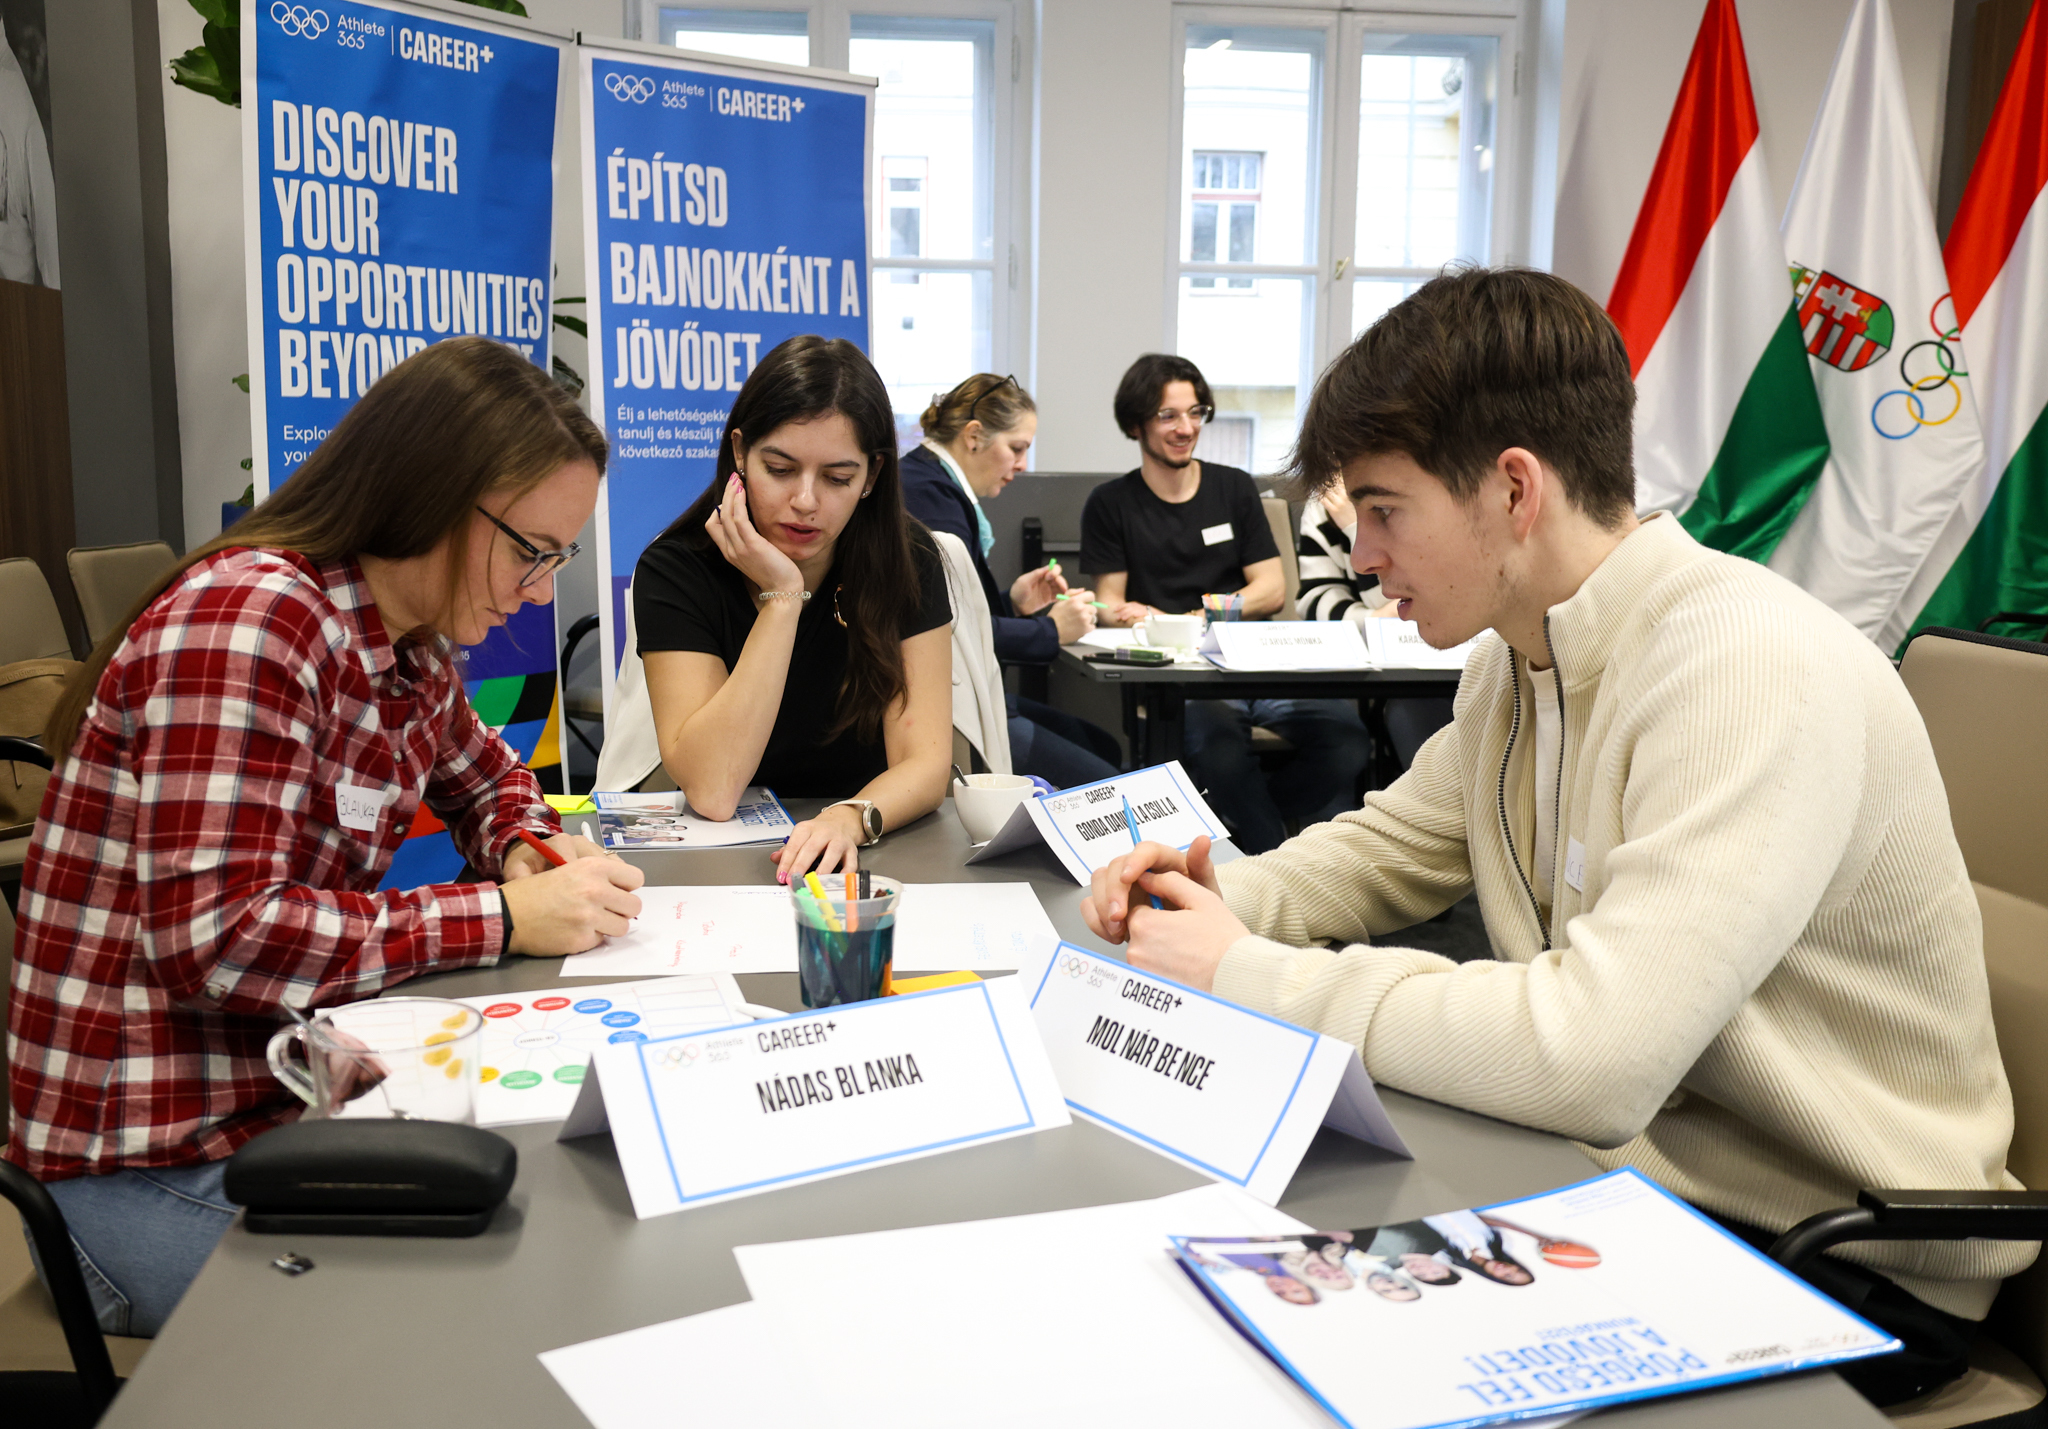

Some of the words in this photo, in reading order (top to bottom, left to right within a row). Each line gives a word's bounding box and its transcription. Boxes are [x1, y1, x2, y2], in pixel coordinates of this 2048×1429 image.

[337, 15, 385, 36] Athlete
[337, 31, 365, 50] 365
[399, 27, 494, 73] CAREER+
[661, 95, 687, 109] 365
[662, 80, 705, 97] Athlete
[717, 87, 805, 122] CAREER+
[272, 99, 458, 194] DISCOVER
[607, 147, 728, 227] ÉPÍTSD
[272, 176, 380, 256] YOUR
[610, 242, 831, 315] BAJNOKKÉNT
[840, 259, 860, 317] A
[276, 253, 543, 340] OPPORTUNITIES
[278, 328, 428, 399] BEYON
[614, 318, 761, 392] JÖVŐDET
[618, 403, 634, 424] Élj
[637, 410, 645, 421] a
[283, 425, 332, 445] Explor
[618, 426, 654, 443] tanulj
[657, 427, 672, 440] és
[675, 426, 713, 443] készülj
[619, 445, 683, 459] következő
[685, 446, 720, 459] szakas
[1085, 785, 1115, 804] CAREER+
[1076, 817, 1112, 841] GONDA
[1143, 797, 1180, 820] CSILLA
[1087, 977, 1104, 988] 365
[1091, 965, 1118, 982] Athlete
[1121, 978, 1183, 1014] CAREER+
[758, 1021, 836, 1053] CAREER+
[1154, 1042, 1215, 1091] BENCE
[756, 1070, 834, 1114] NÁDAS
[1631, 1327, 1669, 1347] A
[1456, 1376, 1535, 1406] FEL
